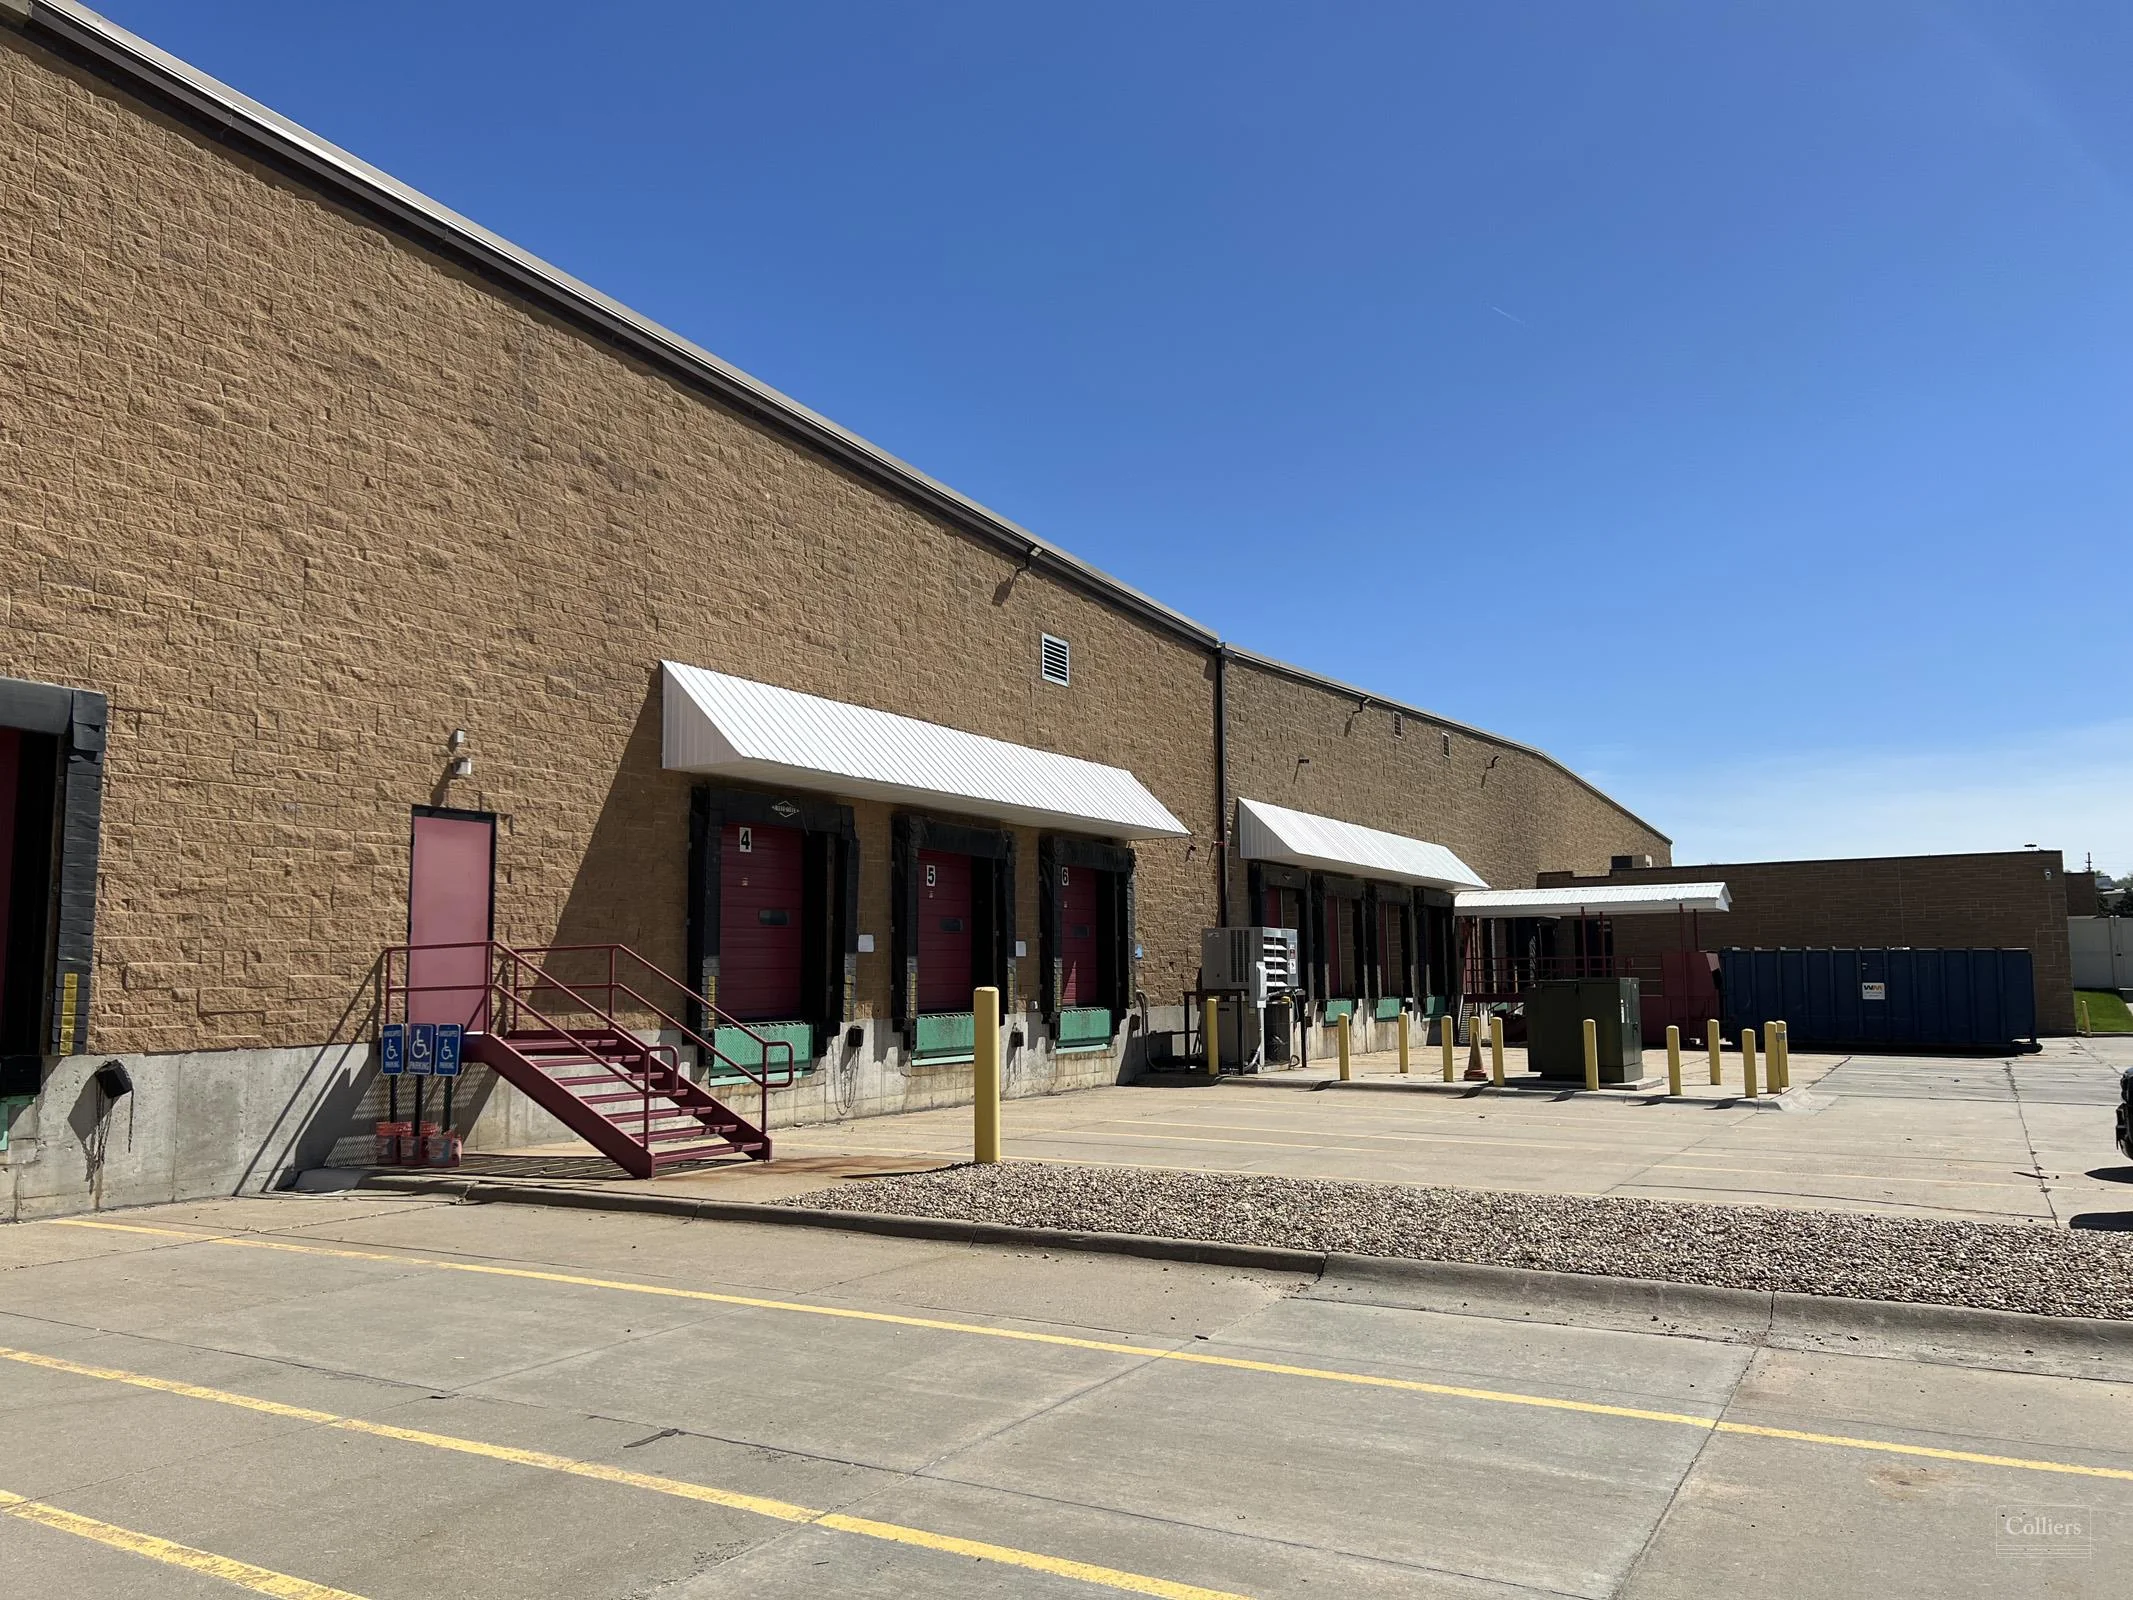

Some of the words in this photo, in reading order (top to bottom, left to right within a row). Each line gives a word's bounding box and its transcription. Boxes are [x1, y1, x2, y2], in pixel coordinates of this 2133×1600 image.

[741, 830, 750, 850] 4
[928, 867, 934, 884] 5
[1063, 868, 1068, 884] 6
[409, 1061, 430, 1070] PARKING
